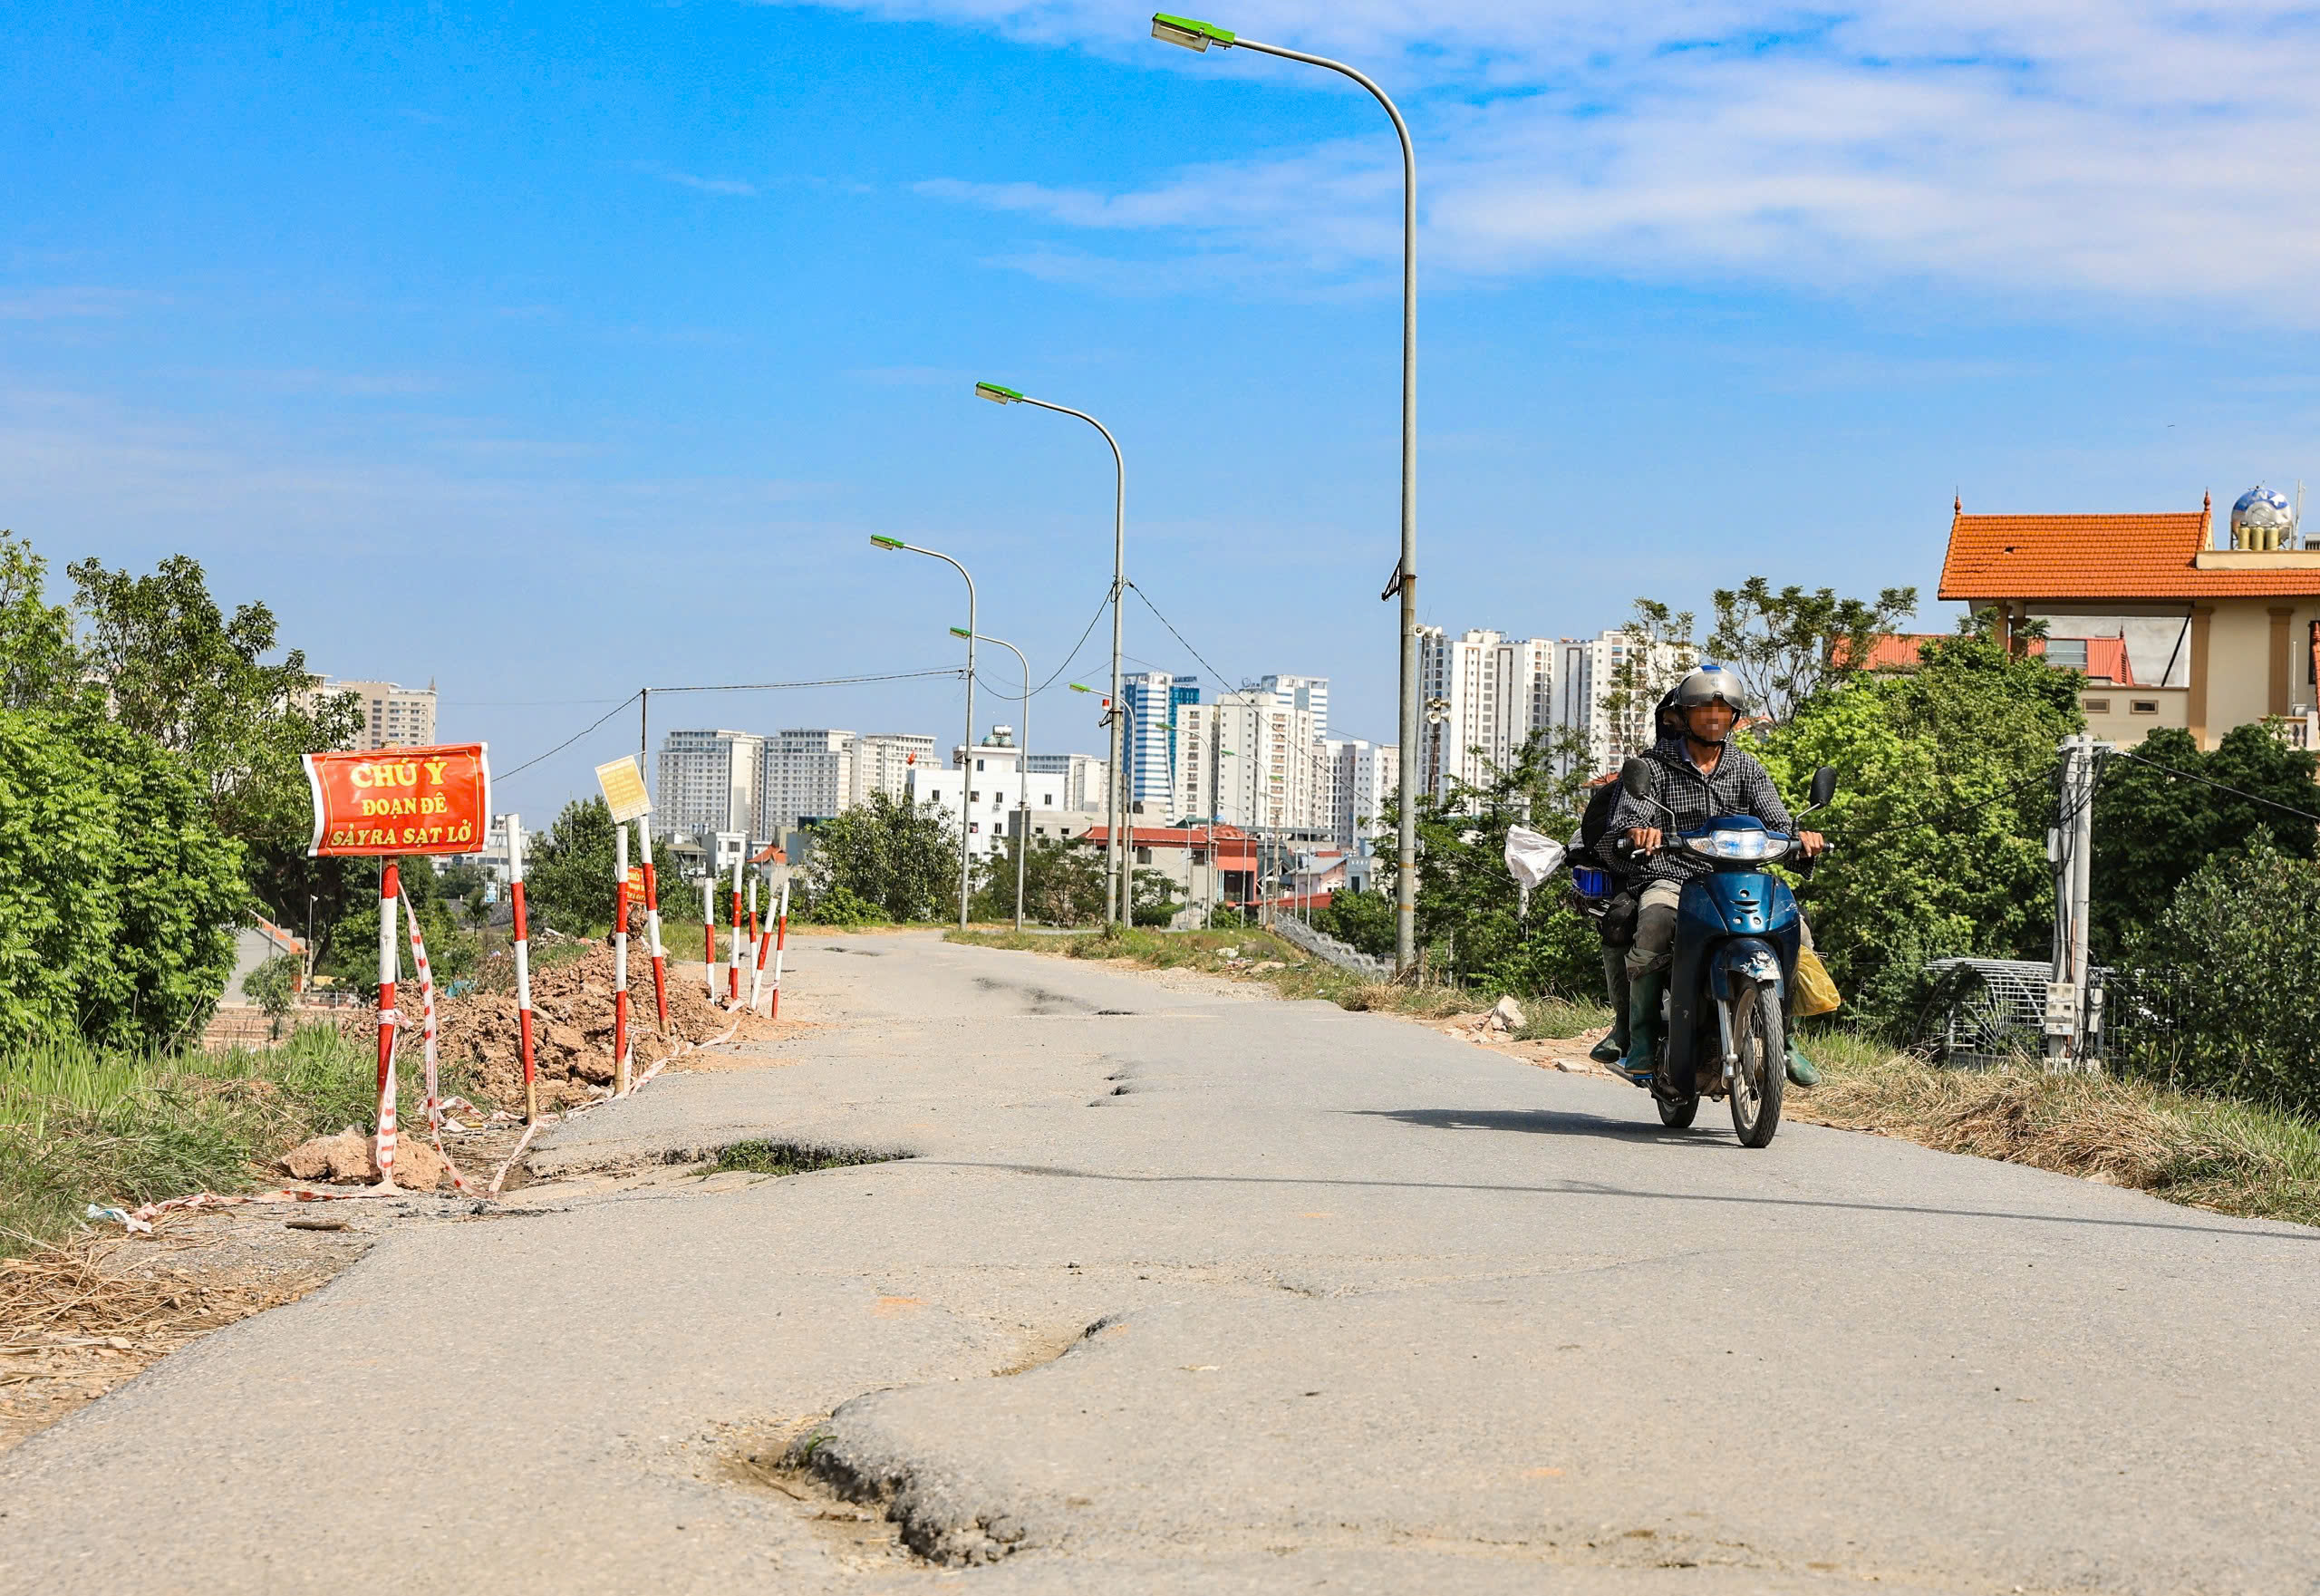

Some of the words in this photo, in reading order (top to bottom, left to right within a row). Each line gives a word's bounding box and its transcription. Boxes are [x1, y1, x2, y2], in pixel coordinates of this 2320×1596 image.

[350, 758, 418, 788] CHÚ
[424, 756, 448, 785] Ý
[362, 798, 417, 819] ĐOẠN
[420, 791, 448, 814] ĐÊ
[402, 827, 443, 847] SẠT
[447, 818, 472, 843] LỞ
